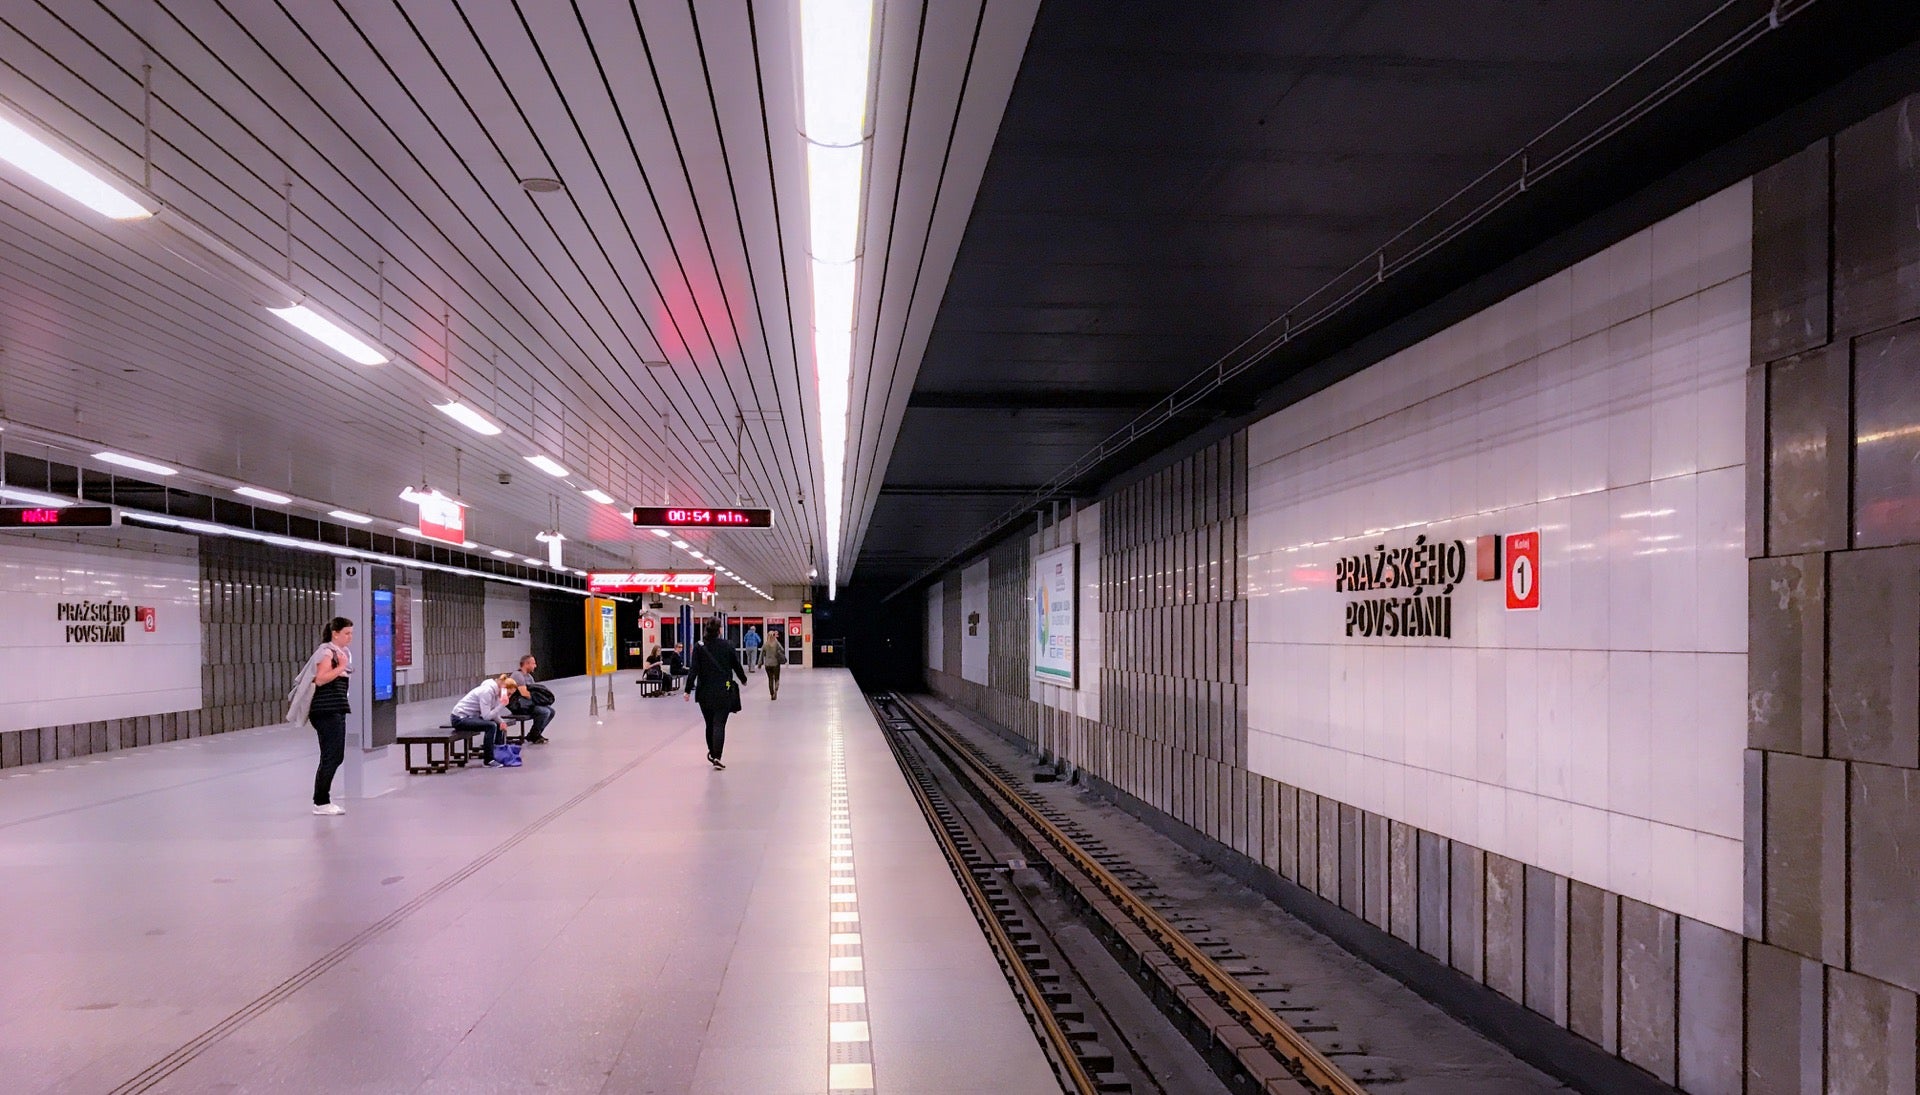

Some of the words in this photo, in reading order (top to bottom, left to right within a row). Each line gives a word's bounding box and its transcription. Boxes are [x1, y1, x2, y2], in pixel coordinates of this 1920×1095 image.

[667, 510, 711, 523] 00:54
[717, 510, 750, 523] min.
[1335, 534, 1466, 592] PRAŽSKÉHO
[1517, 562, 1525, 594] 1
[58, 600, 130, 621] PRAŽSKÉHO
[1345, 584, 1454, 639] POVSTÁNÍ
[66, 621, 125, 643] POVSTÁNÍ
